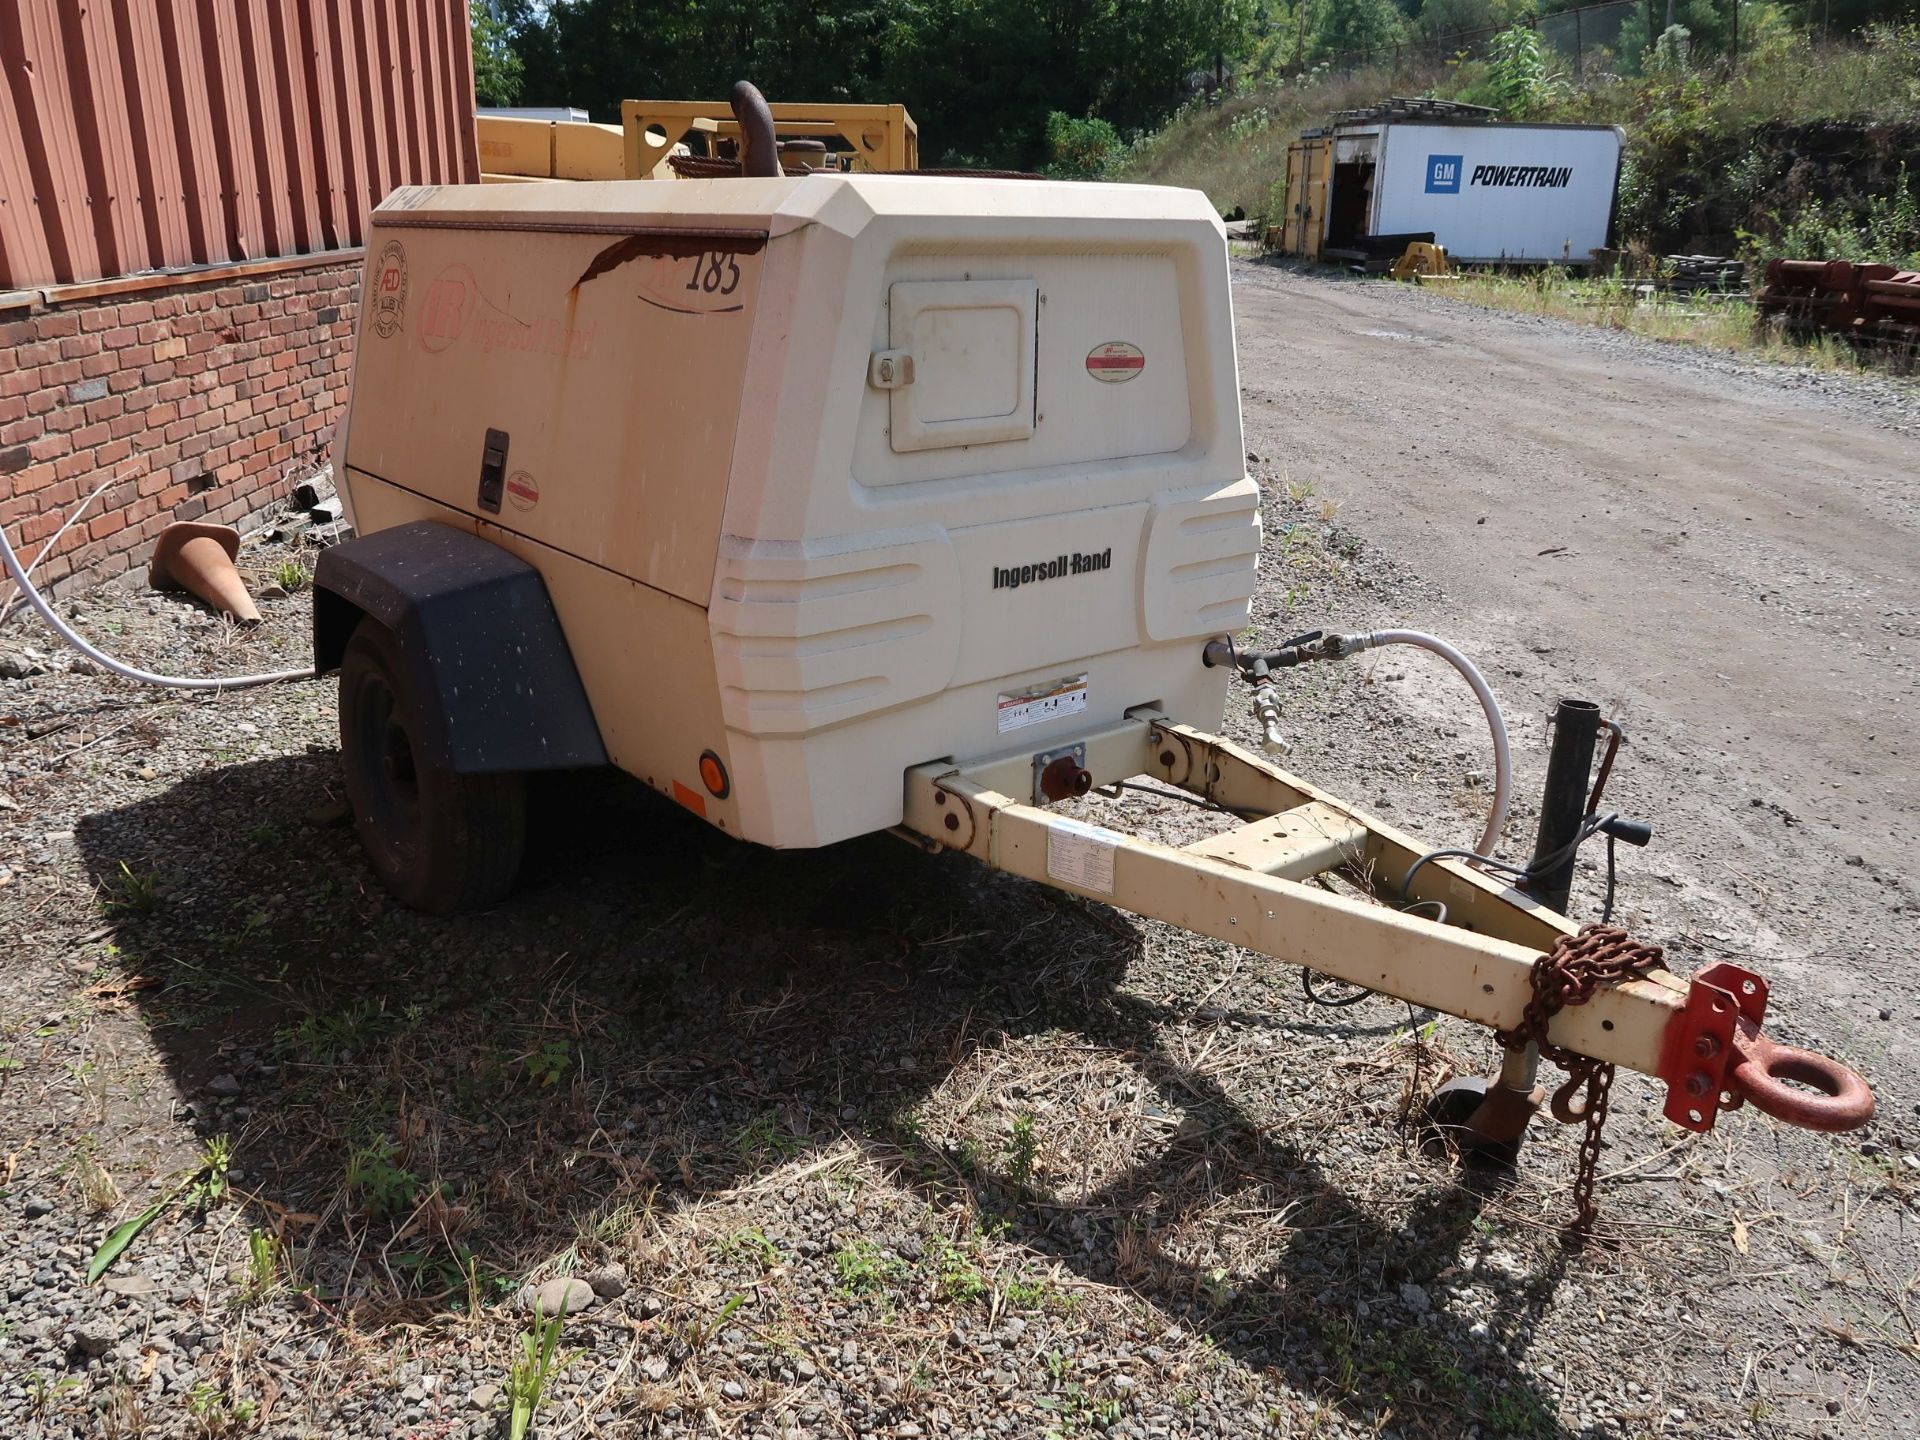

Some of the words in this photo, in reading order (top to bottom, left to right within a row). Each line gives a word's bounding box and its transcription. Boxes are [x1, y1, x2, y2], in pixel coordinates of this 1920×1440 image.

[1434, 162, 1455, 180] GM
[1470, 165, 1573, 188] POWERTRAIN
[686, 250, 741, 295] 185
